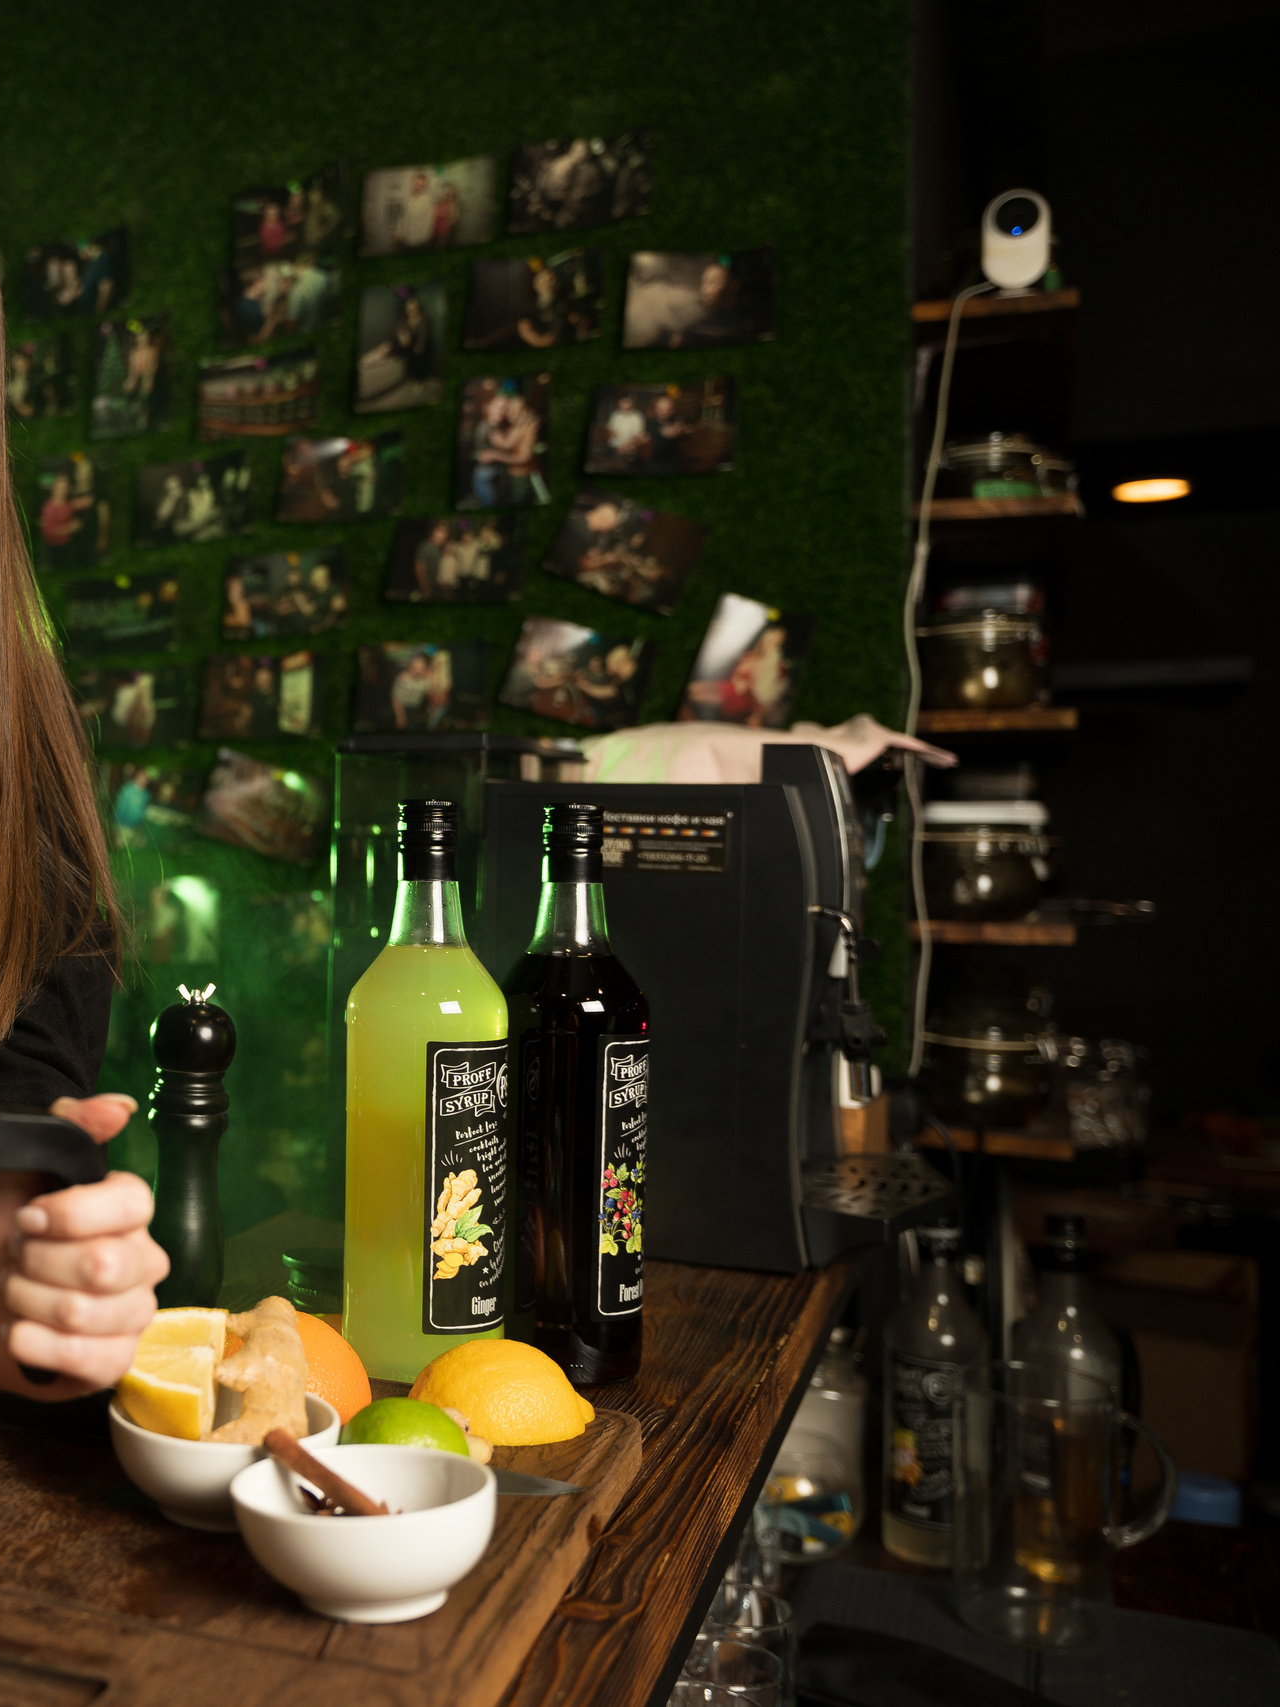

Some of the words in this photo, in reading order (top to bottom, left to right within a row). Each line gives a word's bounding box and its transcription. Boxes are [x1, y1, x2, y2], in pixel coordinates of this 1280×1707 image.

[657, 812, 690, 827] кофе
[691, 815, 701, 825] и
[452, 1067, 492, 1087] PROFF
[619, 1059, 647, 1079] PROFF
[445, 1092, 489, 1113] SYRUP
[613, 1083, 645, 1105] SYRUP
[468, 1135, 500, 1153] cocktails
[471, 1296, 497, 1316] Ginger
